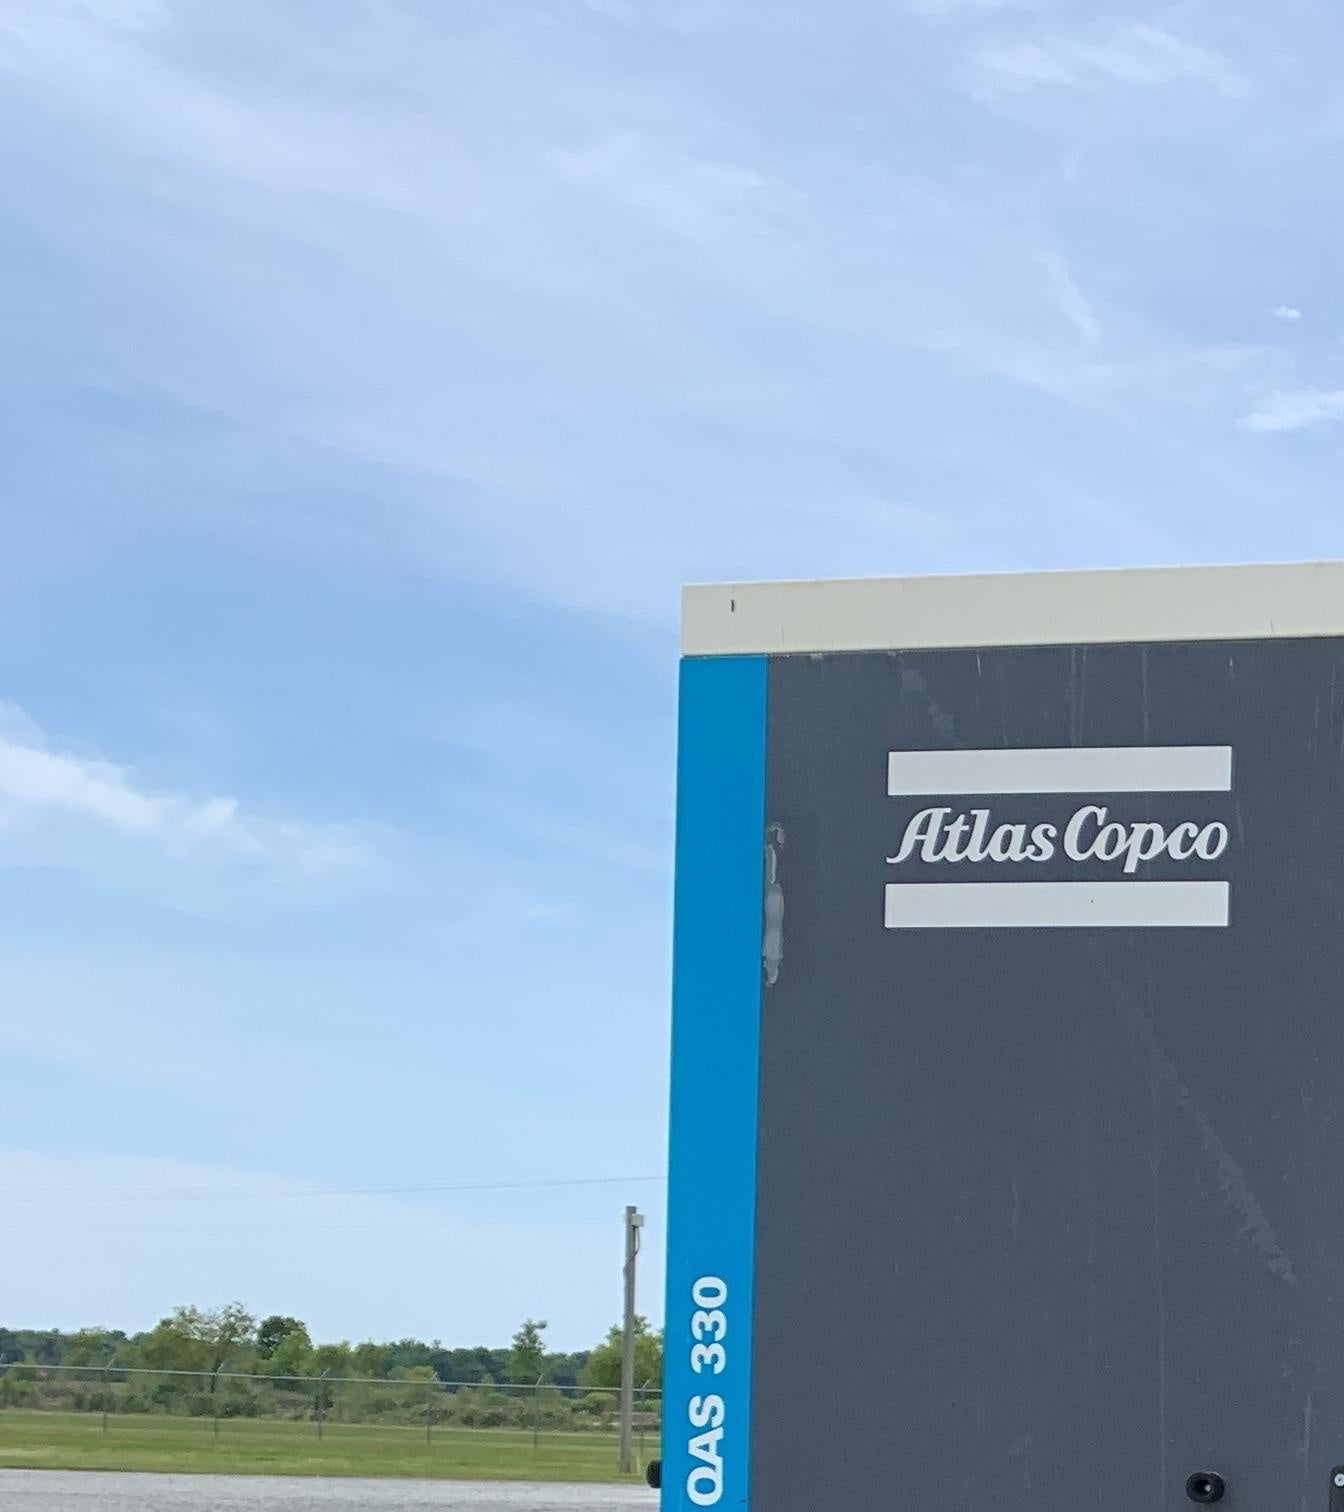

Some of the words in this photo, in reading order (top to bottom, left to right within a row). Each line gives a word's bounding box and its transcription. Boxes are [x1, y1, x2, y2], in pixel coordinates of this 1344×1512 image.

[886, 807, 1057, 863] Atlas
[1063, 805, 1228, 873] Copco
[690, 1276, 727, 1374] 330
